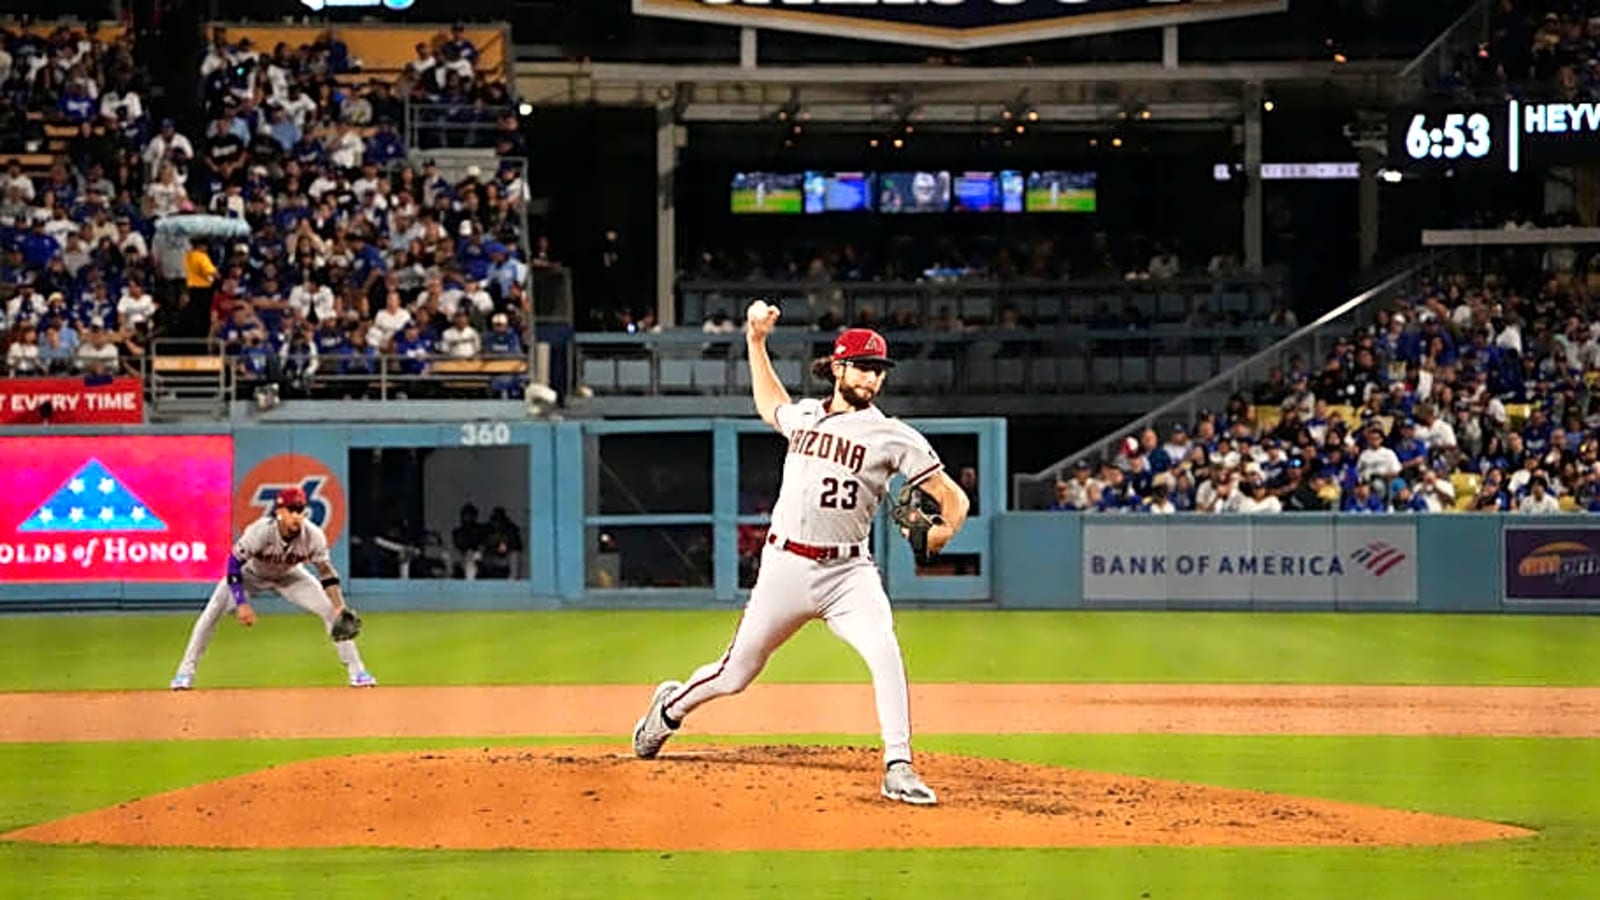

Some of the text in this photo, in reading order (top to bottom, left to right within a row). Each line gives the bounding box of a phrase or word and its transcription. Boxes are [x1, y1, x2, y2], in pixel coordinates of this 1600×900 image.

[1406, 112, 1490, 159] 6:53
[84, 392, 137, 411] TIME
[461, 423, 510, 446] 360
[820, 477, 860, 510] 23
[0, 537, 208, 568] OLDS of HONOR
[1091, 555, 1345, 576] BANK OF AMERICA
